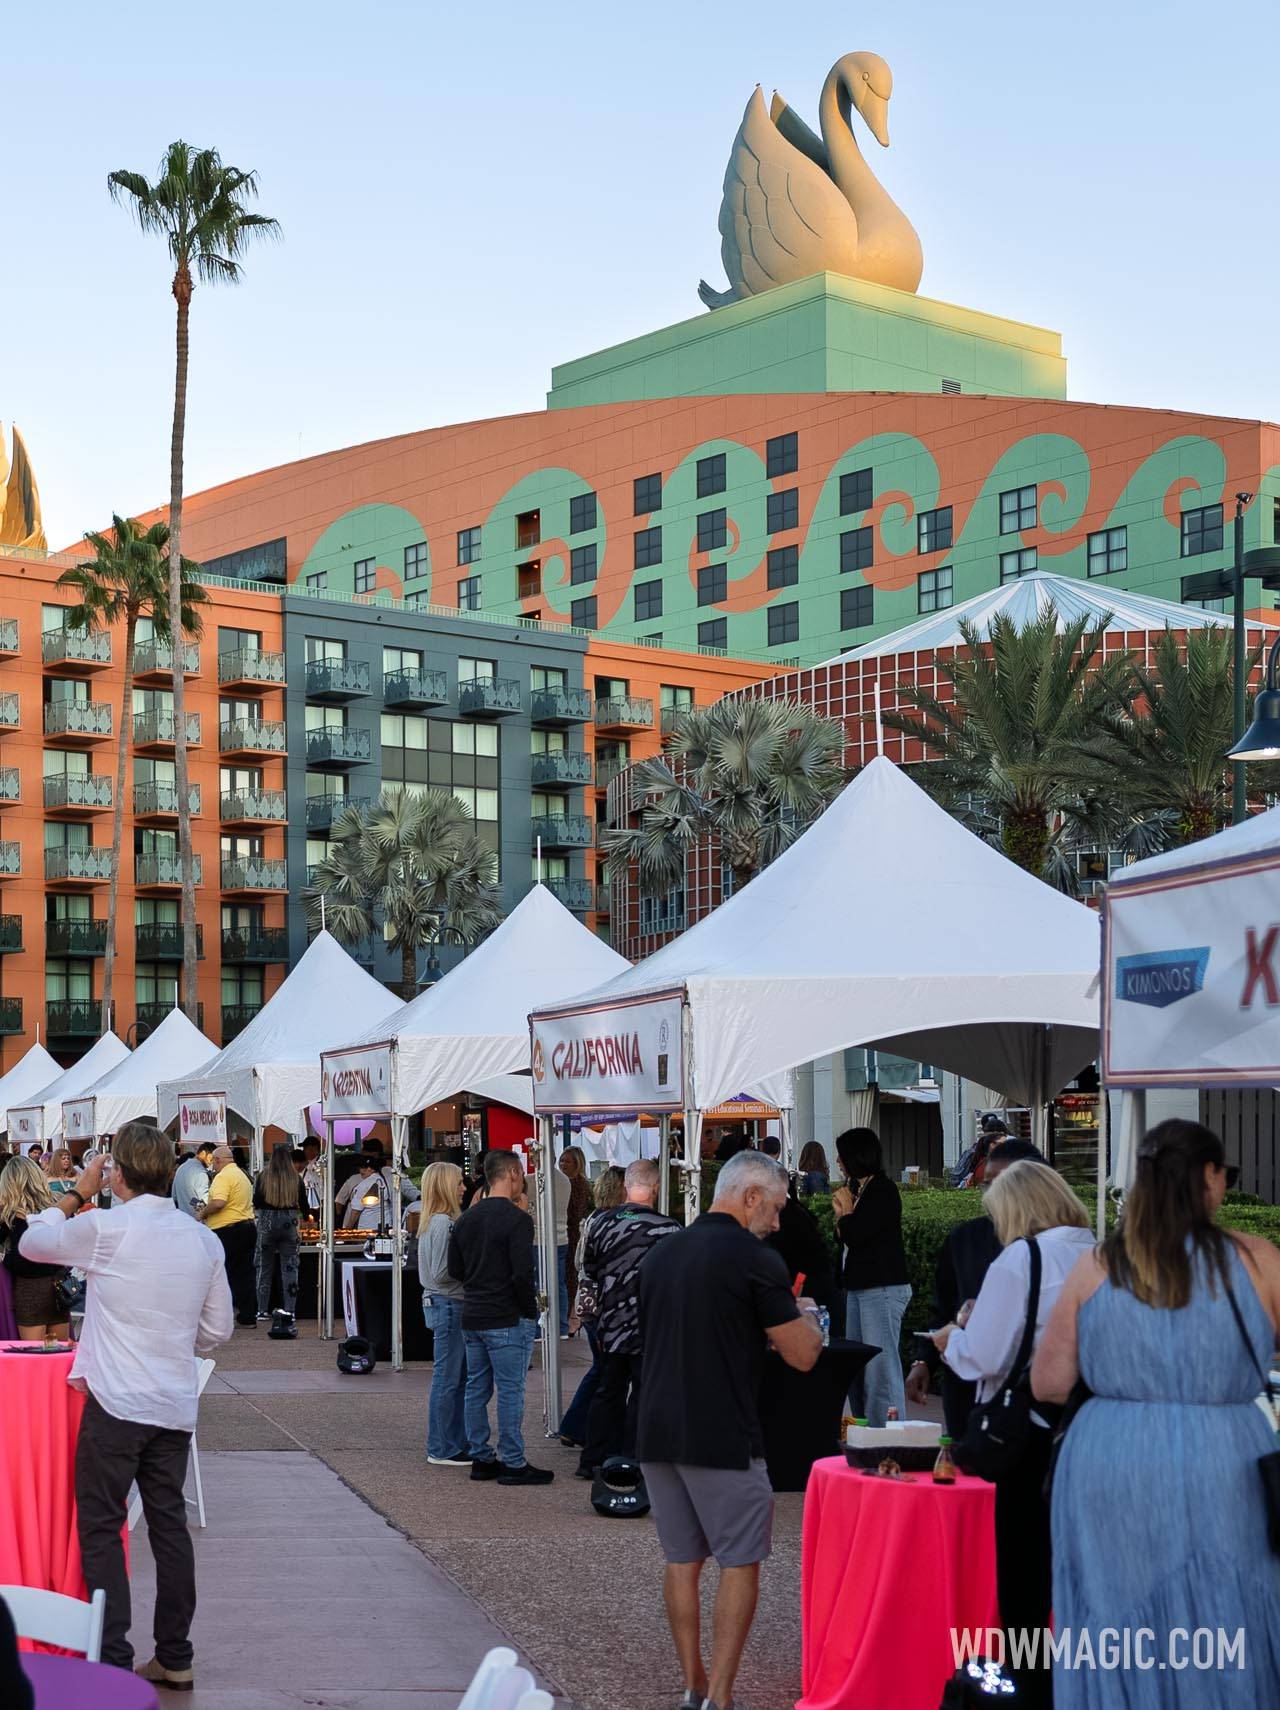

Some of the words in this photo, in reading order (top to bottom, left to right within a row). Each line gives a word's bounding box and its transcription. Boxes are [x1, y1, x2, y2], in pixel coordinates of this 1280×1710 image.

[1126, 967, 1191, 996] KIMONOS
[551, 1031, 644, 1081] CALIFORNIA
[332, 1067, 374, 1099] ARGENTINA
